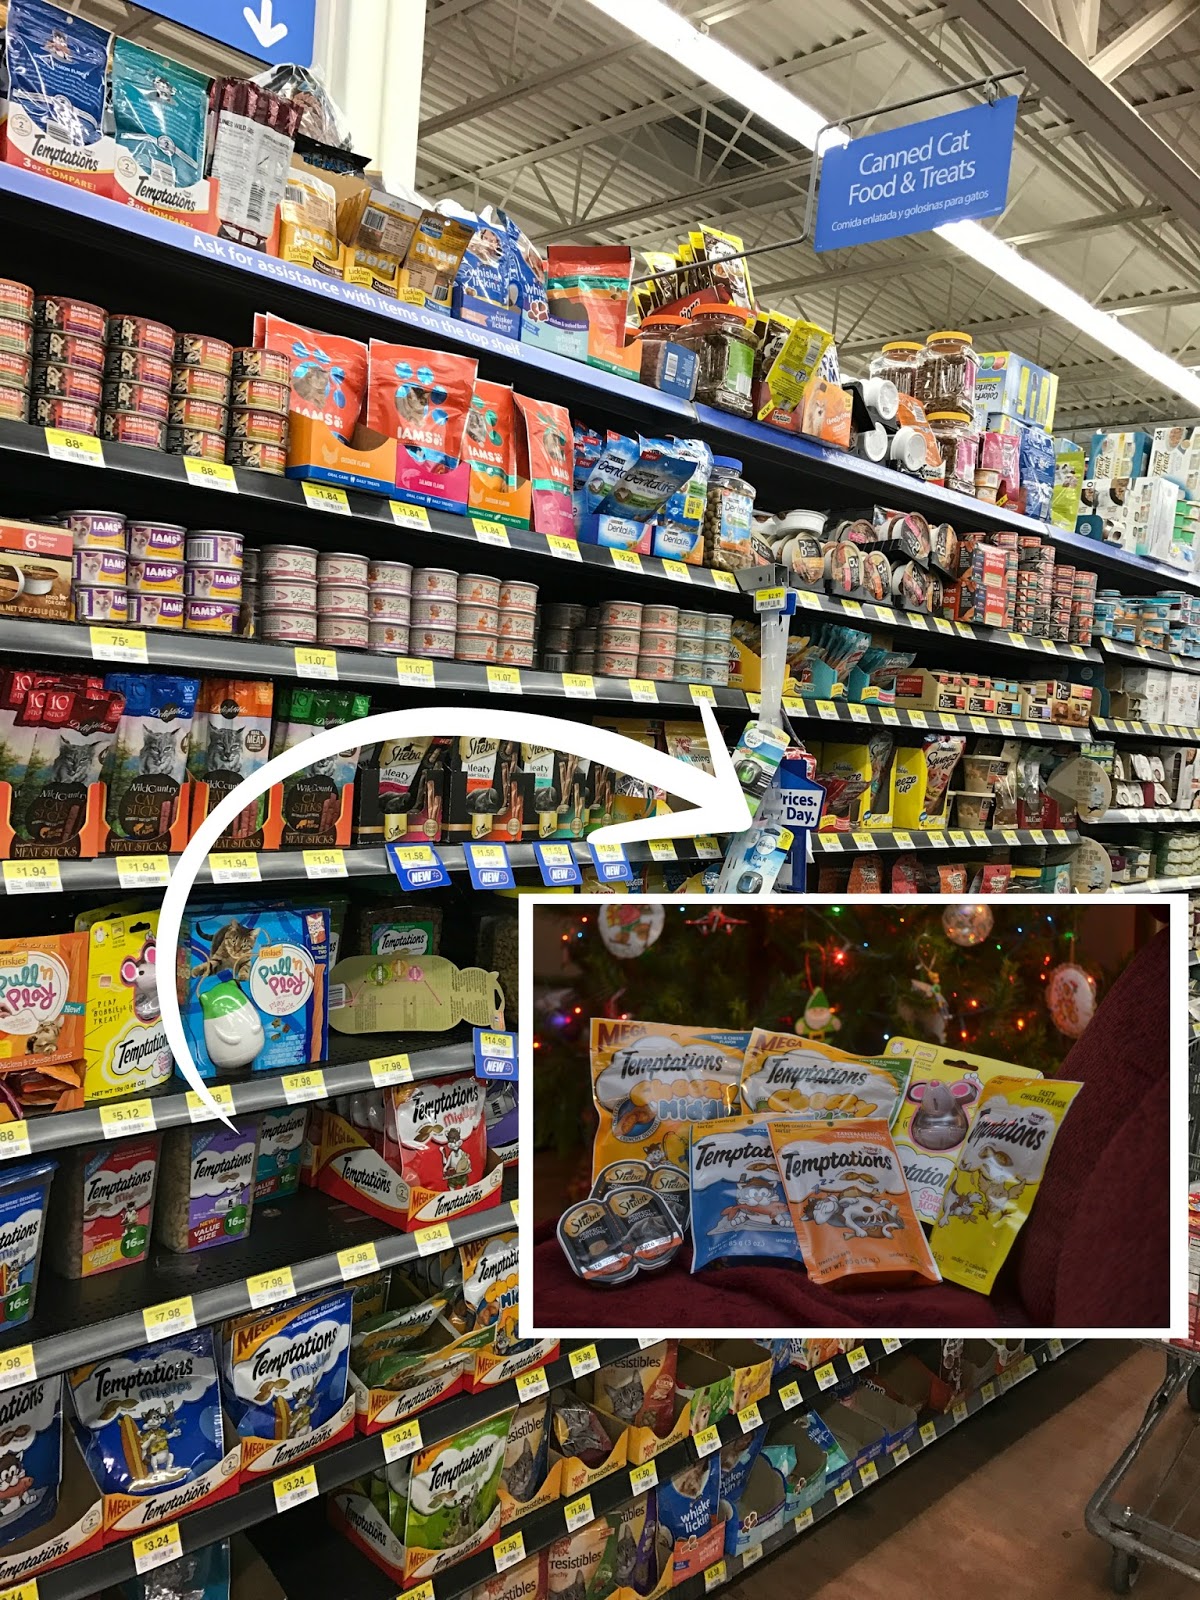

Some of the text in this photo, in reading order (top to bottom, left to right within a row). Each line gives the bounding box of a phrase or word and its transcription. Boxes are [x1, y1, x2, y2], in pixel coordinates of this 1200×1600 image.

[32, 135, 98, 171] Temptations
[859, 129, 971, 176] Canned Cat
[848, 160, 976, 206] Food & Treats
[135, 176, 195, 212] Temptations
[832, 190, 988, 231] Comida enlatada y golosinas para gatos
[193, 234, 524, 357] Ask for assistance with items on the top shelf.
[397, 427, 432, 443] IAMS
[468, 445, 494, 462] IAMS
[316, 489, 338, 502] $1.84
[93, 521, 118, 532] IAMS
[25, 533, 37, 549] 6
[152, 533, 177, 544] IAMS
[104, 557, 125, 569] IAMS
[146, 567, 172, 578] IAMS
[215, 574, 239, 585] IAMS
[768, 592, 781, 600] $2.97
[162, 602, 182, 612] IAMS
[191, 606, 217, 616] IAMS
[305, 656, 327, 665] $1.07
[405, 664, 425, 674] $1.07
[494, 672, 511, 681] $1.07
[50, 696, 69, 710] 10
[247, 735, 264, 744] MEAT
[391, 747, 423, 764] Sheba
[465, 738, 496, 759] Sheba
[927, 752, 960, 767] Squeeze
[383, 768, 411, 780] Meaty
[467, 764, 492, 773] Meaty
[786, 809, 815, 825] Day.
[14, 846, 77, 858] MEAT STICKS
[136, 841, 168, 851] STICKS
[477, 849, 495, 857] $1.58
[313, 855, 335, 865] $1.94
[403, 852, 424, 860] $1.58
[752, 854, 767, 863] CAR
[129, 861, 156, 873] $1.94
[223, 859, 248, 869] $1.94
[605, 864, 620, 876] NEW
[16, 866, 46, 877] $1.94
[411, 871, 432, 884] NEW
[481, 872, 499, 883] NEW
[552, 869, 568, 879] NEW
[382, 932, 425, 949] Temptations
[258, 957, 294, 984] Pull
[269, 973, 307, 996] Play
[6, 982, 56, 1011] Play
[64, 1005, 81, 1013] New!
[485, 1035, 507, 1046] $14.98
[598, 1023, 647, 1046] MEGA
[752, 1035, 803, 1054] MEGA
[381, 1061, 402, 1071] $7.98
[486, 1060, 505, 1072] NEW
[620, 1051, 723, 1080] Temptations
[766, 1058, 868, 1089] Temptations
[290, 1076, 312, 1087] $7.98
[1020, 1093, 1067, 1108] CHICKEN FLAVOR
[1038, 1089, 1056, 1100] TASTY
[412, 1084, 479, 1124] Temptations
[112, 1108, 140, 1121] $5.12
[194, 1152, 252, 1179] Temptations
[782, 1151, 893, 1180] Temptations
[341, 1156, 391, 1194] Temptations
[608, 1169, 643, 1183] Sheba
[87, 1169, 152, 1201] Temptations
[653, 1177, 689, 1191] Sheba
[412, 1190, 430, 1209] MEGA
[435, 1190, 482, 1217] Temptations
[618, 1194, 654, 1215] Sheba
[200, 1218, 217, 1227] NEW!
[227, 1216, 245, 1227] 16oz
[570, 1211, 601, 1231] Sheba
[194, 1222, 220, 1238] VALUE
[423, 1230, 442, 1241] $3.24
[125, 1238, 144, 1249] 16oz
[198, 1232, 217, 1243] SIZE
[347, 1252, 368, 1262] $7.98
[260, 1277, 283, 1289] $7.98
[155, 1308, 181, 1323] $7.98
[251, 1326, 338, 1381] Temptations
[498, 1349, 544, 1379] Temptations
[94, 1359, 194, 1403] Temptations
[523, 1372, 540, 1386] $3.24
[395, 1382, 444, 1416] Temptations
[392, 1430, 412, 1441] $3.24
[244, 1442, 264, 1461] MEGA
[272, 1427, 334, 1466] Temptations
[429, 1443, 495, 1491] Temptations
[283, 1476, 305, 1492] $3.24
[141, 1481, 211, 1524] Temptations
[515, 1493, 551, 1515] Irresistibles
[571, 1503, 586, 1516] $1.50
[144, 1535, 169, 1551] $3.24
[500, 1541, 517, 1555] $1.50
[432, 1537, 482, 1573] Temptations
